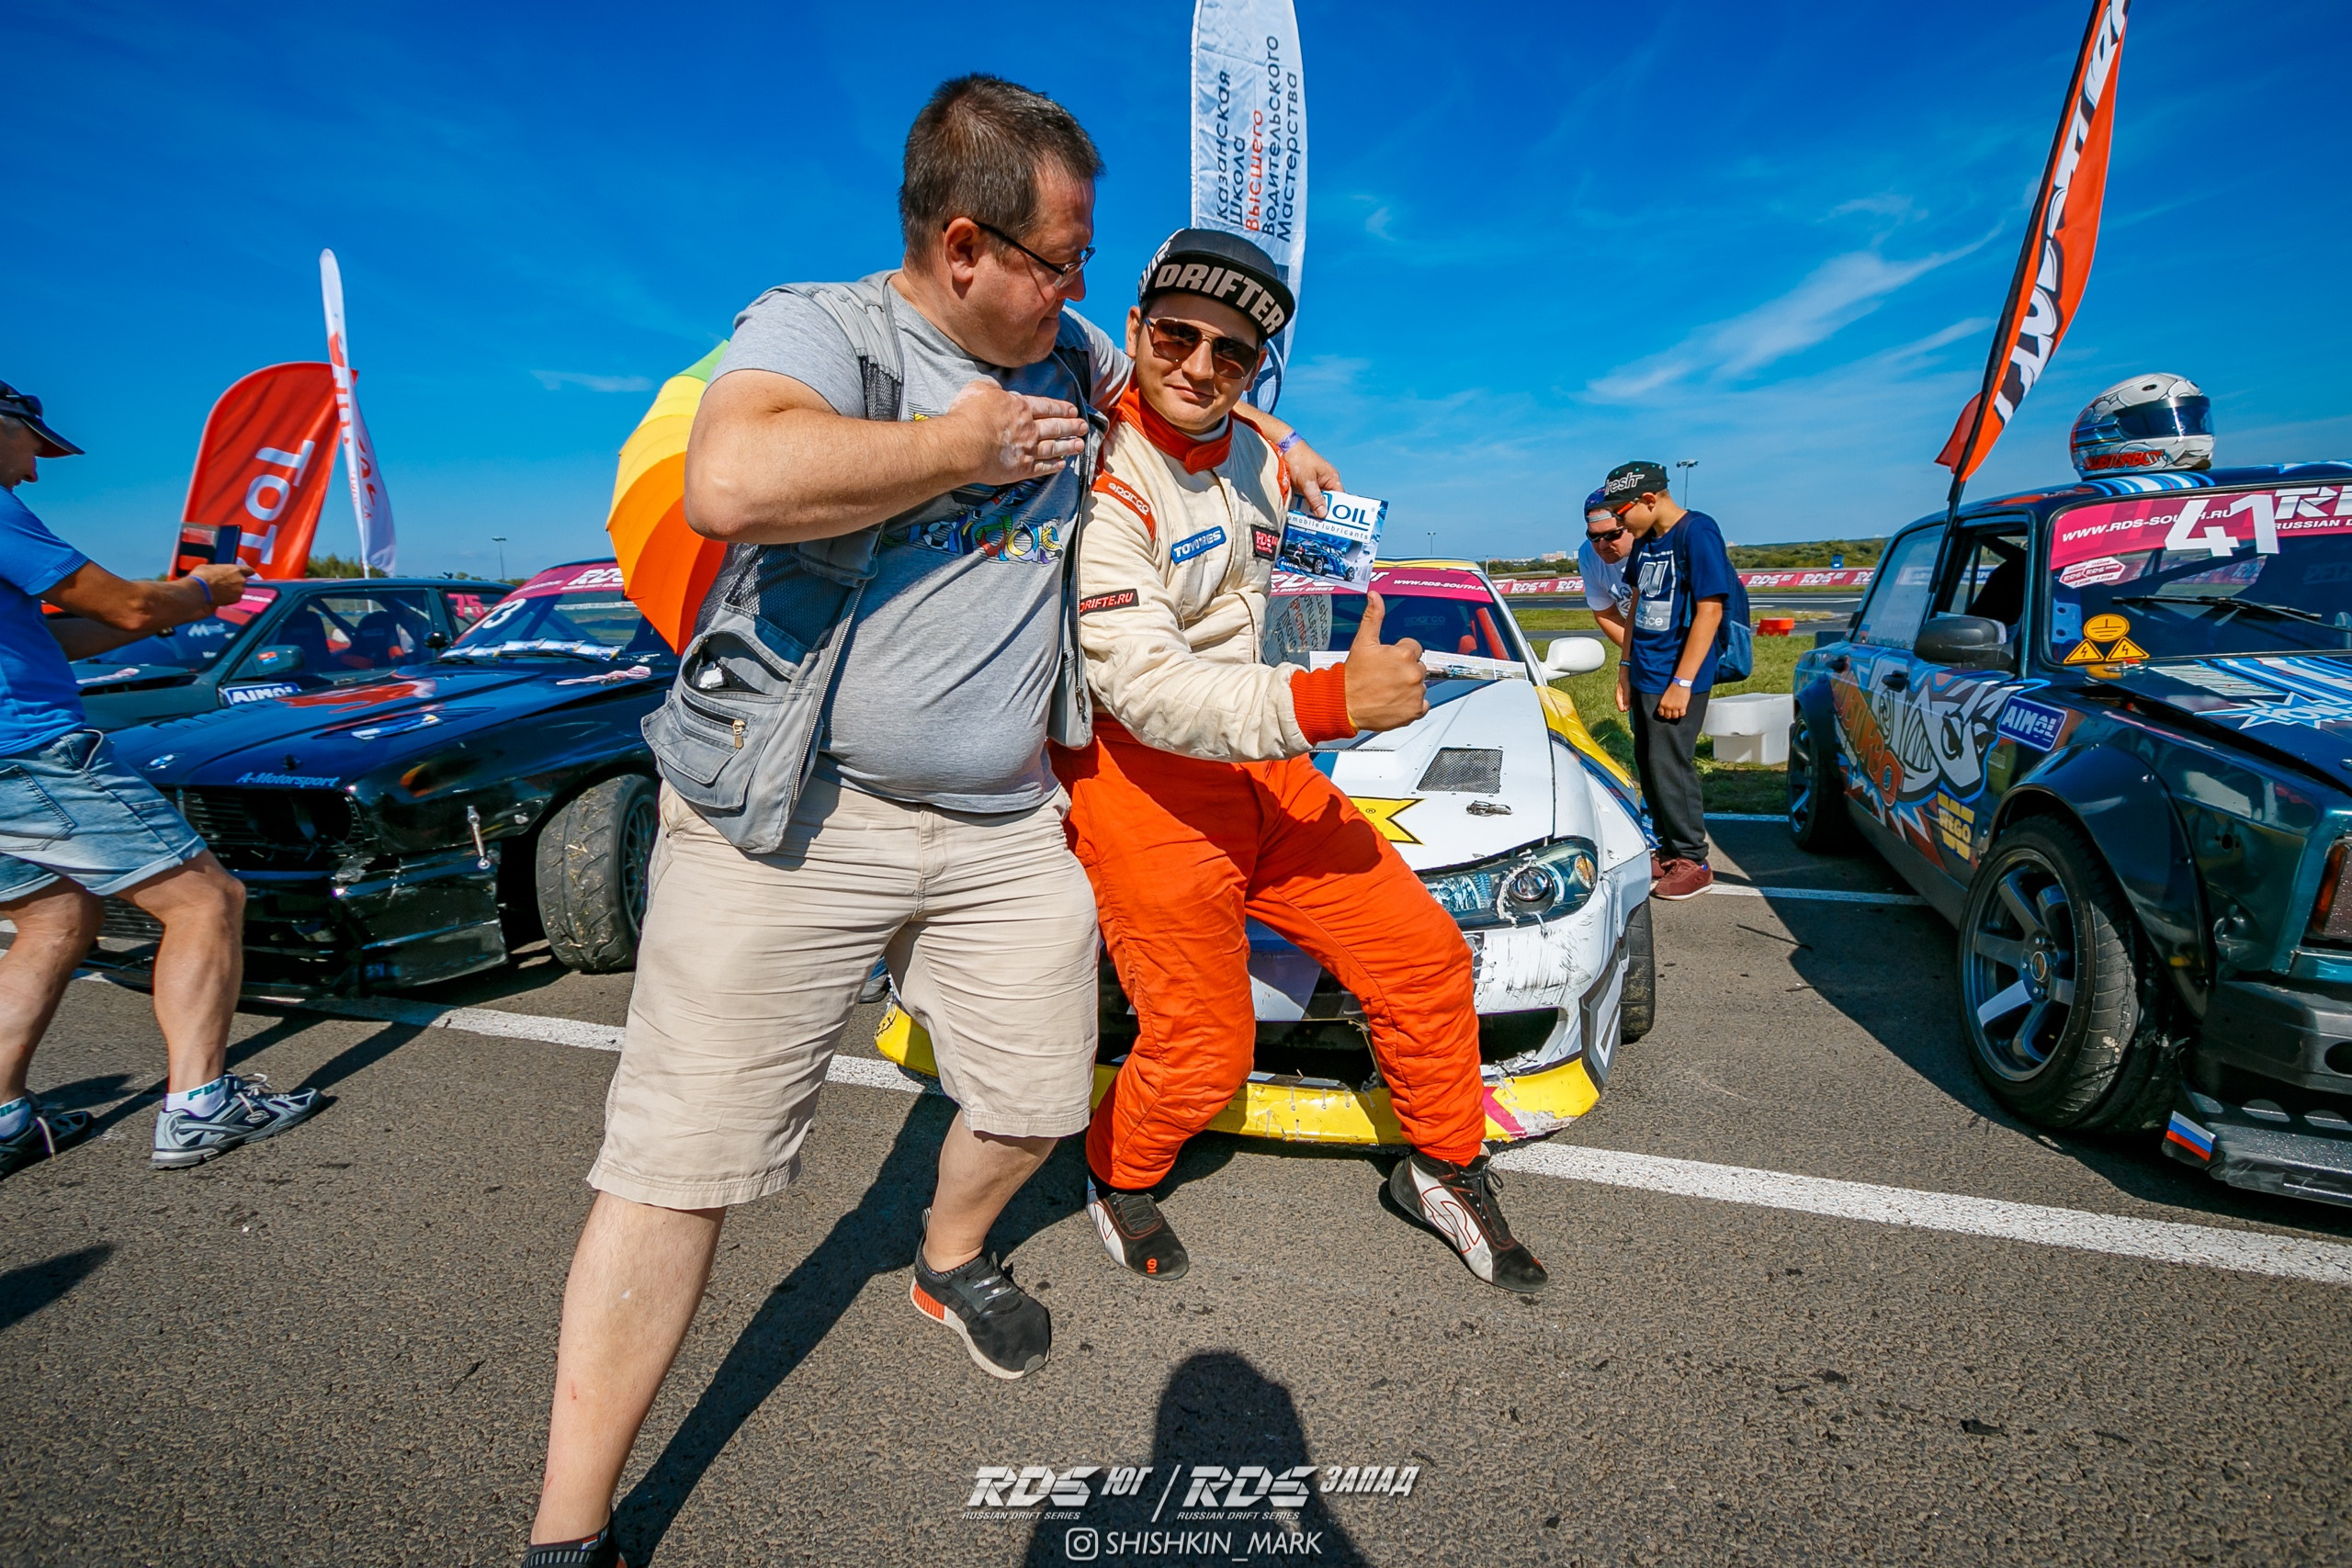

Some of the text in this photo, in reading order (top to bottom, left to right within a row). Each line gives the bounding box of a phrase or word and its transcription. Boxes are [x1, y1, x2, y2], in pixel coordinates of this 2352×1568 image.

[1261, 35, 1280, 237] Водительского
[1245, 109, 1264, 232] Высшего
[1276, 73, 1302, 243] Мастерства
[1228, 137, 1246, 228] Школа
[1155, 264, 1285, 334] DRIFTER
[1108, 481, 1150, 516] sparco
[1332, 503, 1371, 526] OIL
[1321, 521, 1369, 540] lubricants
[2164, 493, 2280, 558] 41
[1747, 575, 1781, 585] RDS
[1801, 572, 1835, 584] RDS
[447, 593, 485, 618] 75
[2001, 705, 2057, 738] AIMOL
